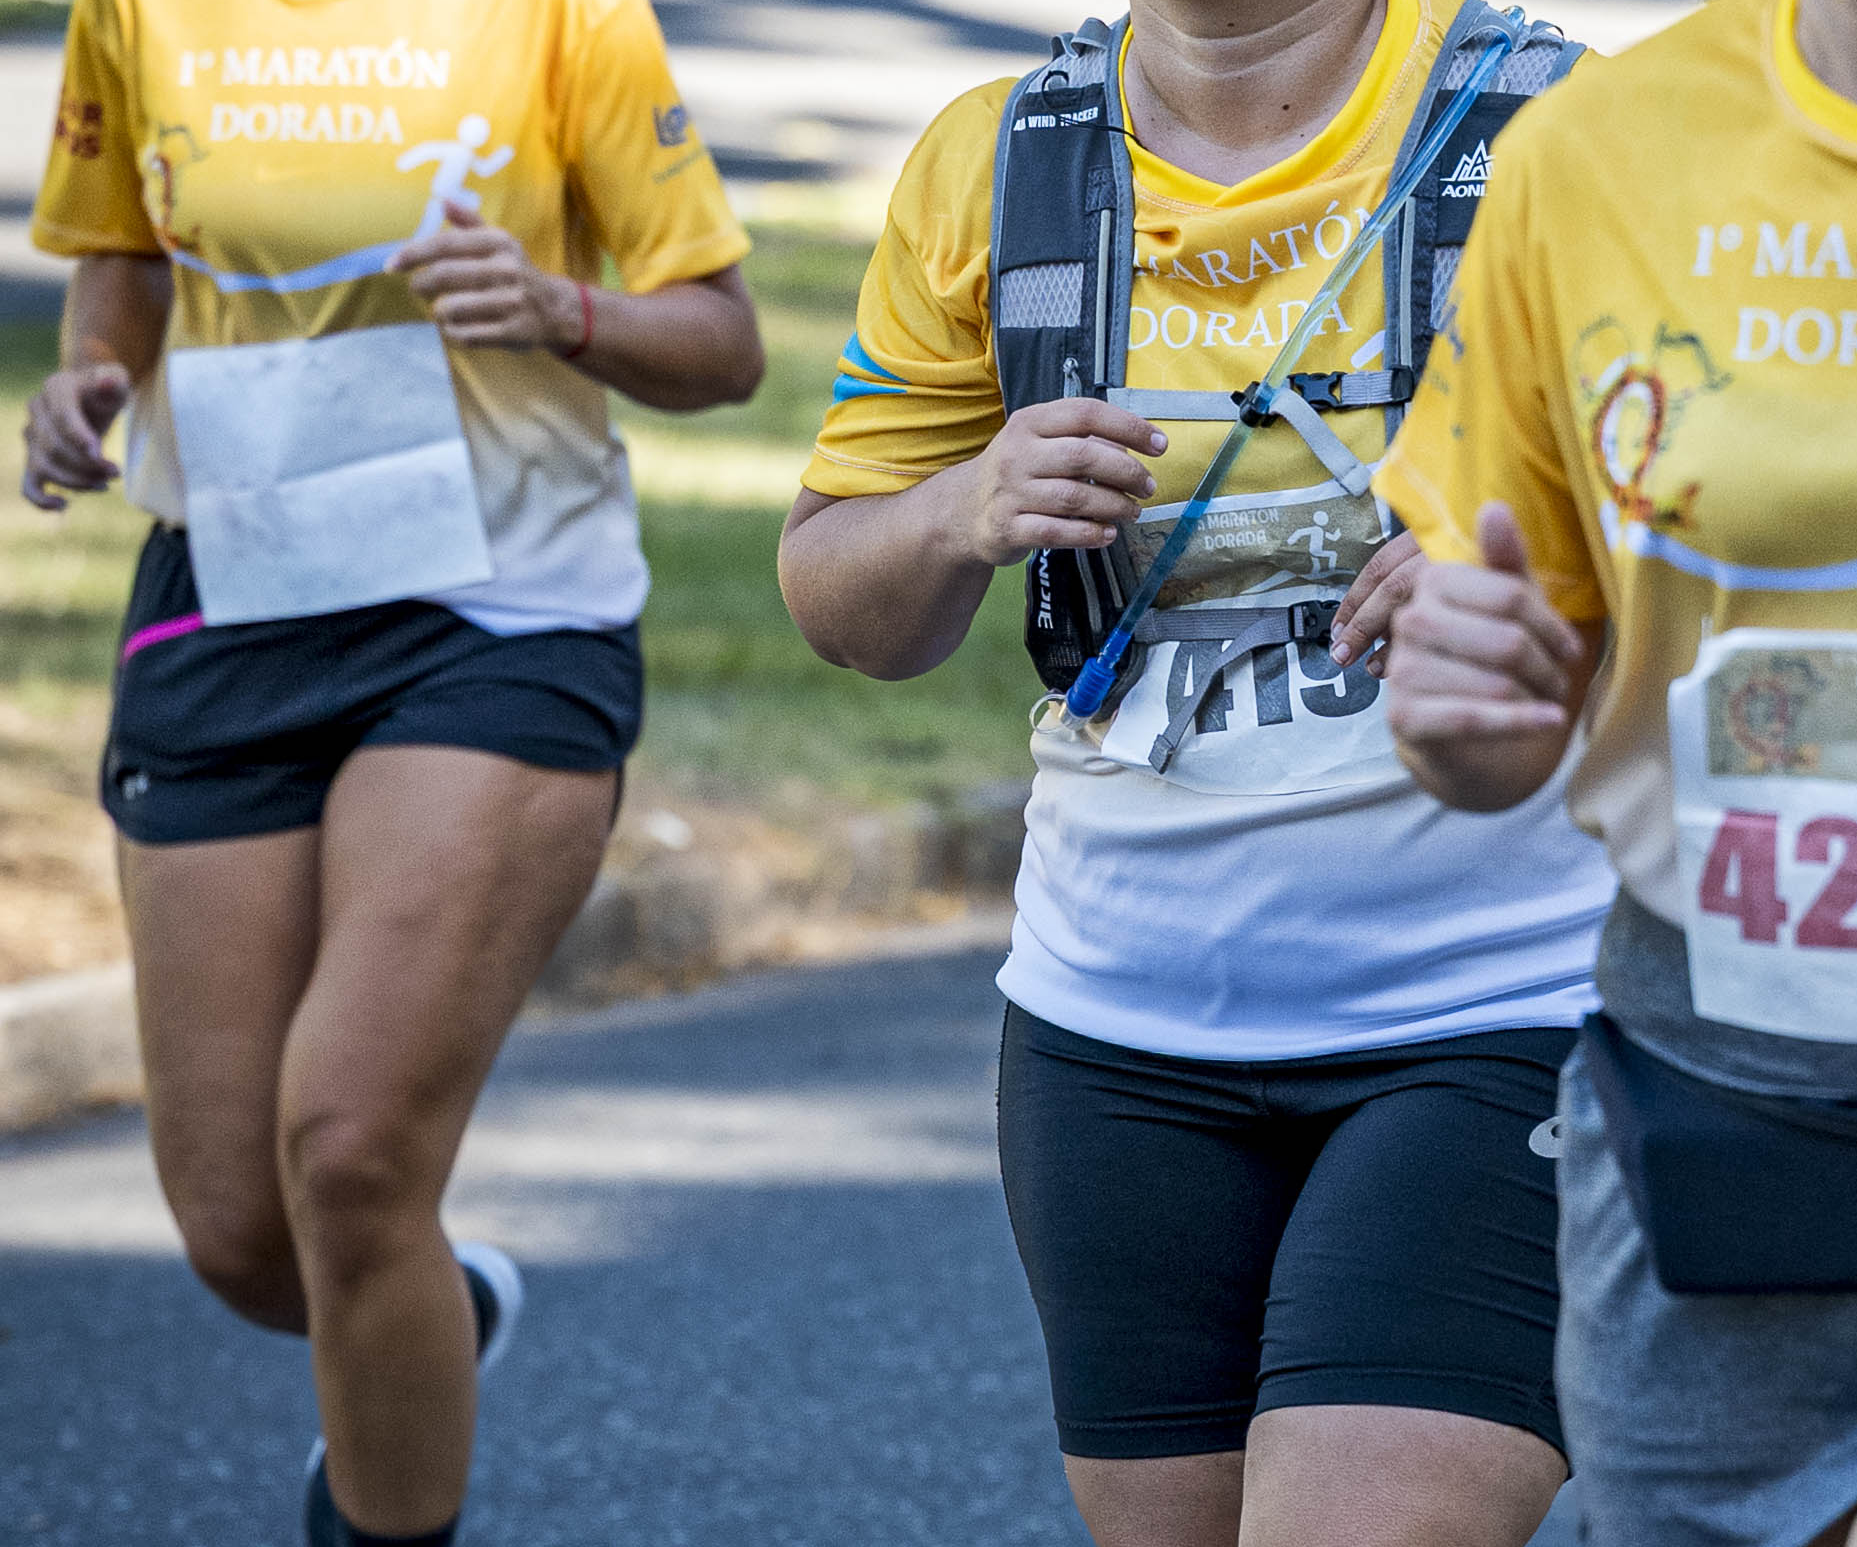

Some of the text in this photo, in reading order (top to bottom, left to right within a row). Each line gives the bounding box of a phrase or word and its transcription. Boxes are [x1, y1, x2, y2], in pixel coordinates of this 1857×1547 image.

[220, 36, 451, 89] MARATÓN
[208, 101, 404, 146] DORADA
[1028, 114, 1057, 129] WIND
